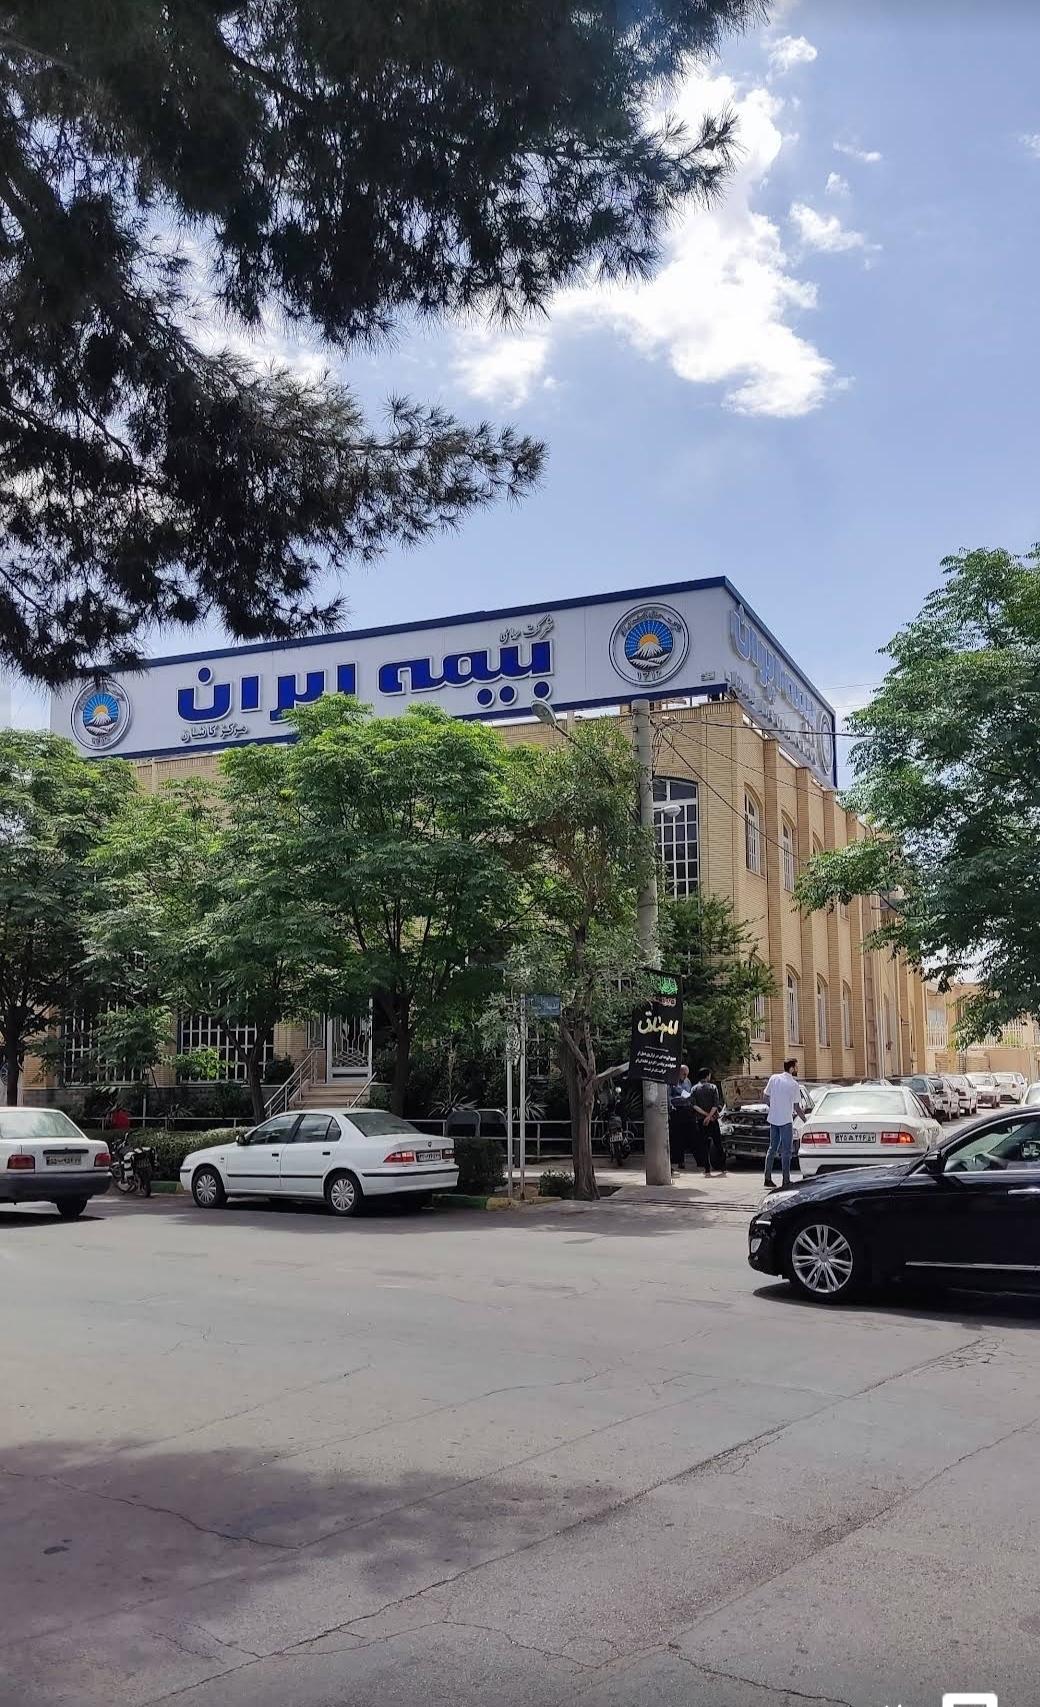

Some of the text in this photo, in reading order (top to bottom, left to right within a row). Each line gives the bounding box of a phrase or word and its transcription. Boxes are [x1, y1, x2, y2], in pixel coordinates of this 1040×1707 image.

[523, 613, 554, 639] شرکت
[177, 660, 358, 724] ایران
[378, 640, 554, 708] بیمه
[181, 723, 249, 743] مرکز کاشان
